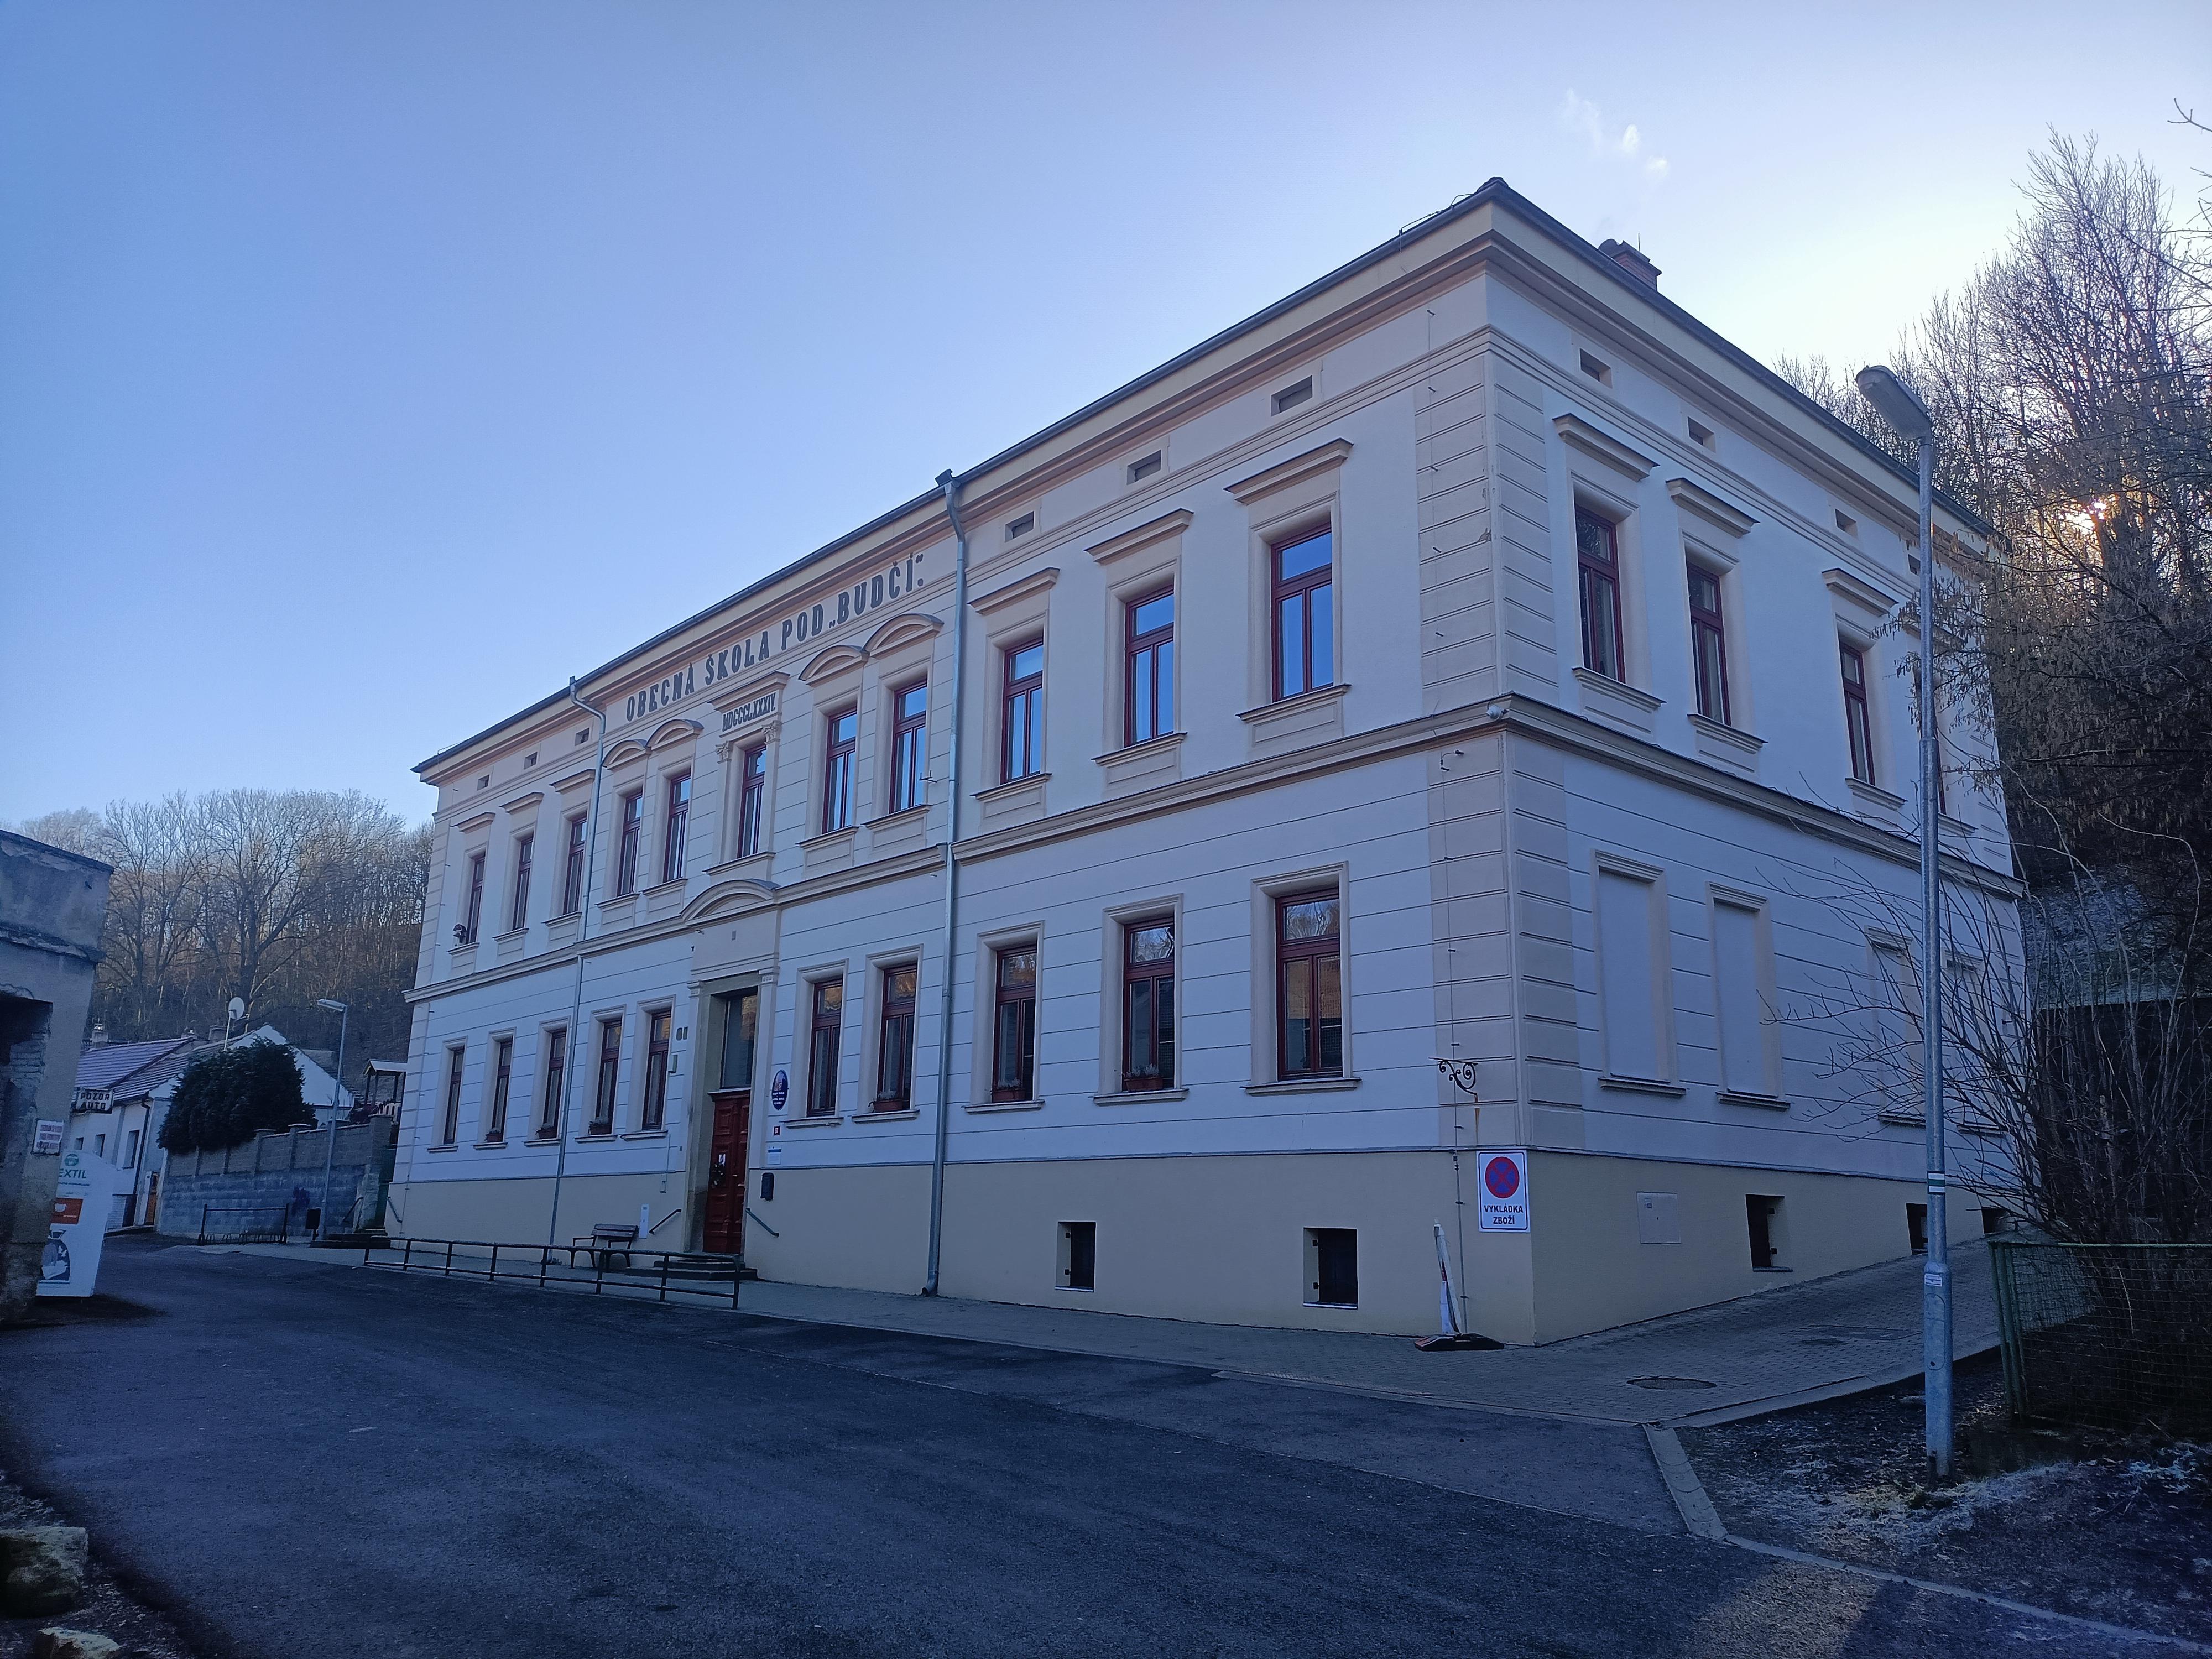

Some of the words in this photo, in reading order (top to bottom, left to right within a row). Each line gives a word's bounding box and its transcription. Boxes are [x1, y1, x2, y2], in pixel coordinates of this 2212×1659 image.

[626, 662, 695, 722] OBECNÁ
[705, 630, 770, 686] ŠKOLA
[781, 604, 824, 651] POD
[80, 1092, 110, 1100] POZOR
[80, 1102, 106, 1110] AUTO
[58, 1168, 87, 1179] EXTIL
[1484, 1203, 1524, 1213] VYKLÁDKA
[1493, 1215, 1515, 1224] ZBOŽÍ
